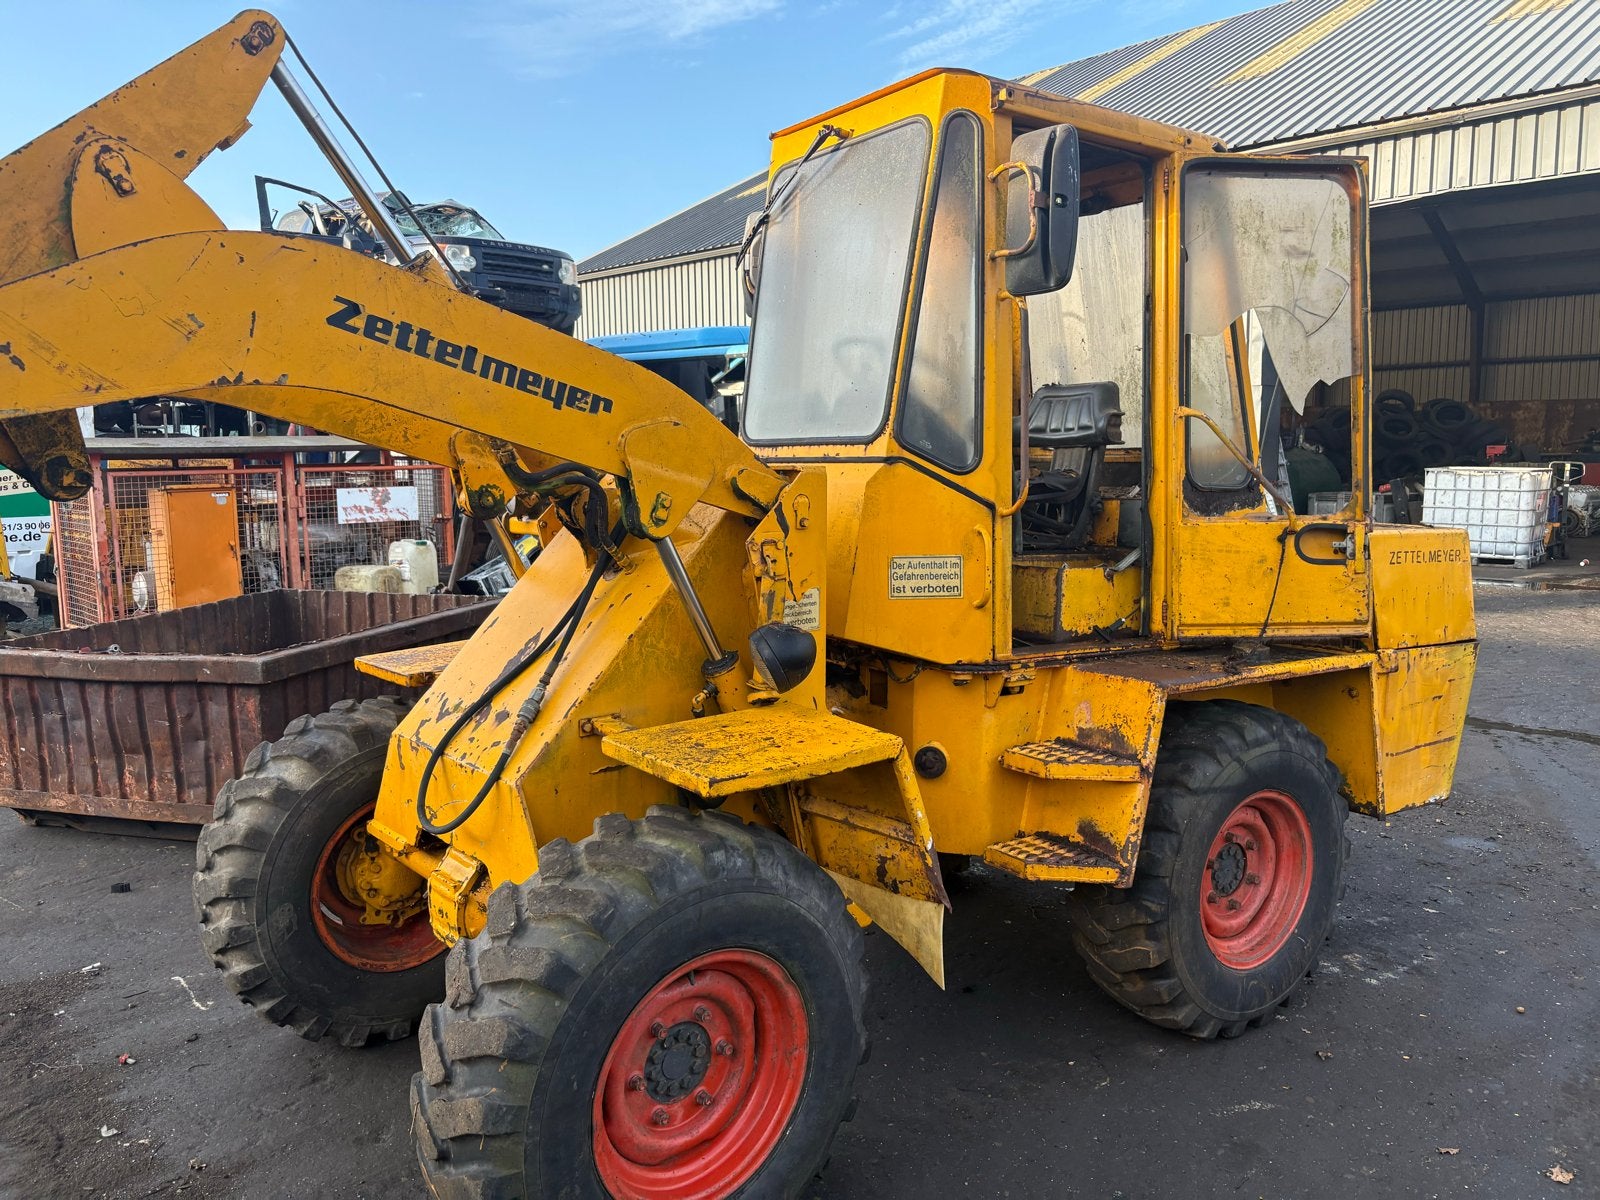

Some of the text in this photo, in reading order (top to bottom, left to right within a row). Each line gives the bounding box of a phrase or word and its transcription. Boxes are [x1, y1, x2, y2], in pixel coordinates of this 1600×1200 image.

[325, 294, 614, 415] Zettelmeyer
[12, 482, 19, 490] &
[25, 522, 37, 530] 90
[1389, 549, 1461, 565] ZETTELMEYER
[892, 560, 960, 570] Der Aufenthalt im
[892, 571, 959, 581] Gefahrenbereich
[892, 583, 959, 594] ist verboten
